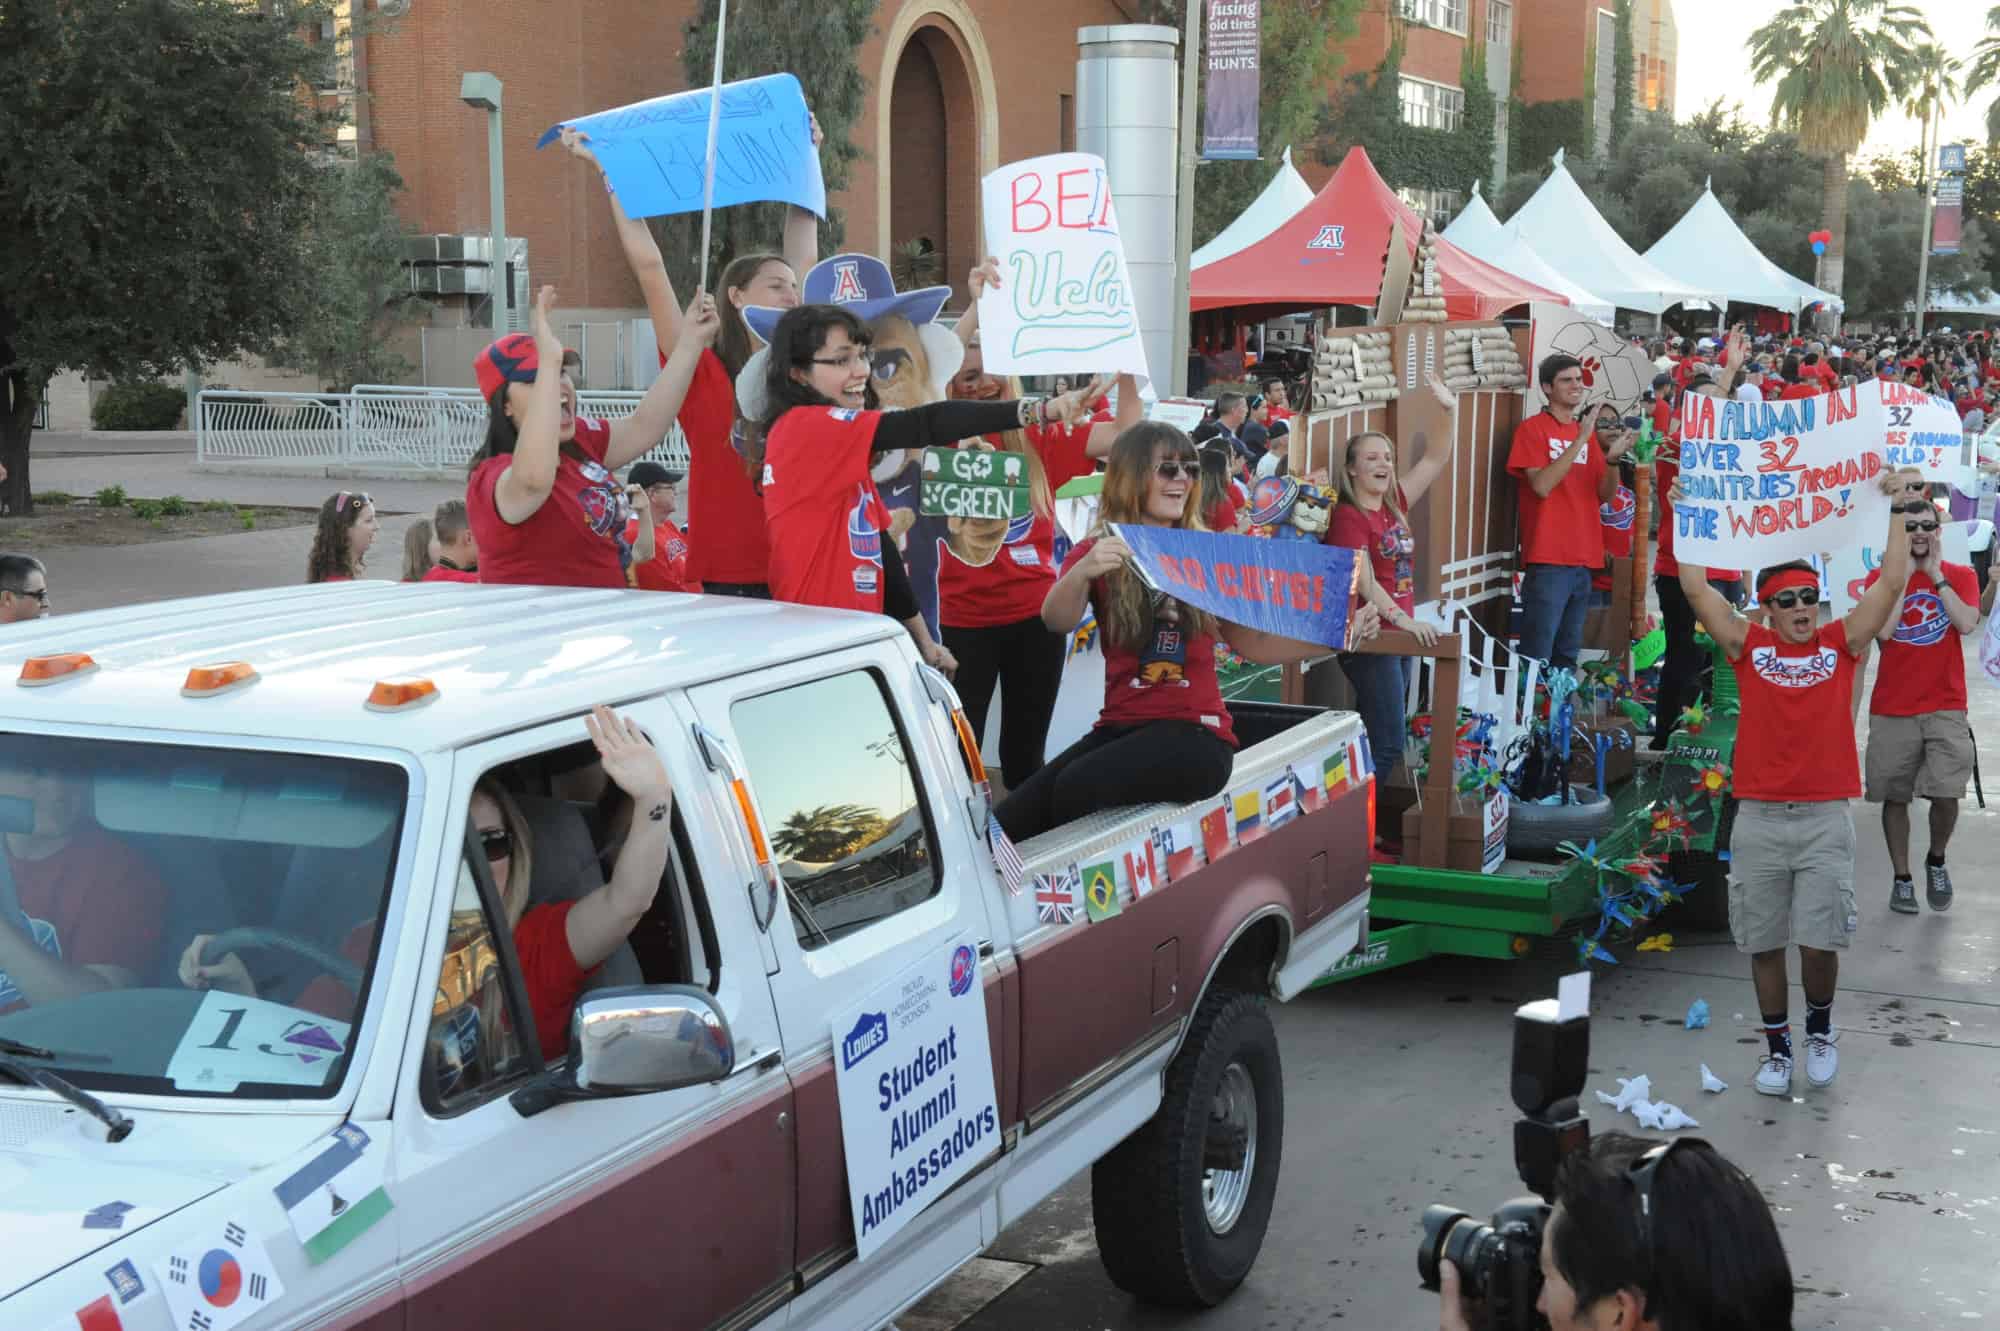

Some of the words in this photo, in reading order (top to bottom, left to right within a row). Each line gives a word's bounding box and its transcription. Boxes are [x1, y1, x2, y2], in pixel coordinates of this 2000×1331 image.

[1209, 1, 1256, 20] fusing
[1209, 19, 1228, 31] old
[1230, 18, 1256, 30] tires
[1208, 56, 1258, 70] HUNTS.
[1306, 225, 1344, 249] A
[830, 261, 867, 304] A
[1683, 391, 1715, 440] UA
[1720, 398, 1816, 441] ALUMNI
[1826, 384, 1857, 425] IN
[1887, 406, 1913, 427] 32
[952, 451, 993, 481] GO
[1680, 441, 1743, 472] OVER
[1757, 436, 1808, 473] 32
[1798, 451, 1882, 495] AROUND
[941, 483, 1014, 519] GREEN
[1674, 503, 1719, 541] THE
[1158, 554, 1206, 592] GO
[1214, 563, 1325, 613] CATS!
[891, 981, 938, 1020] HOMECOMING
[901, 975, 924, 997] PROUD
[900, 1000, 931, 1030] SPONSOR
[879, 1024, 957, 1112] Student
[890, 1074, 957, 1160] Alumni
[862, 1104, 995, 1238] Ambassadors
